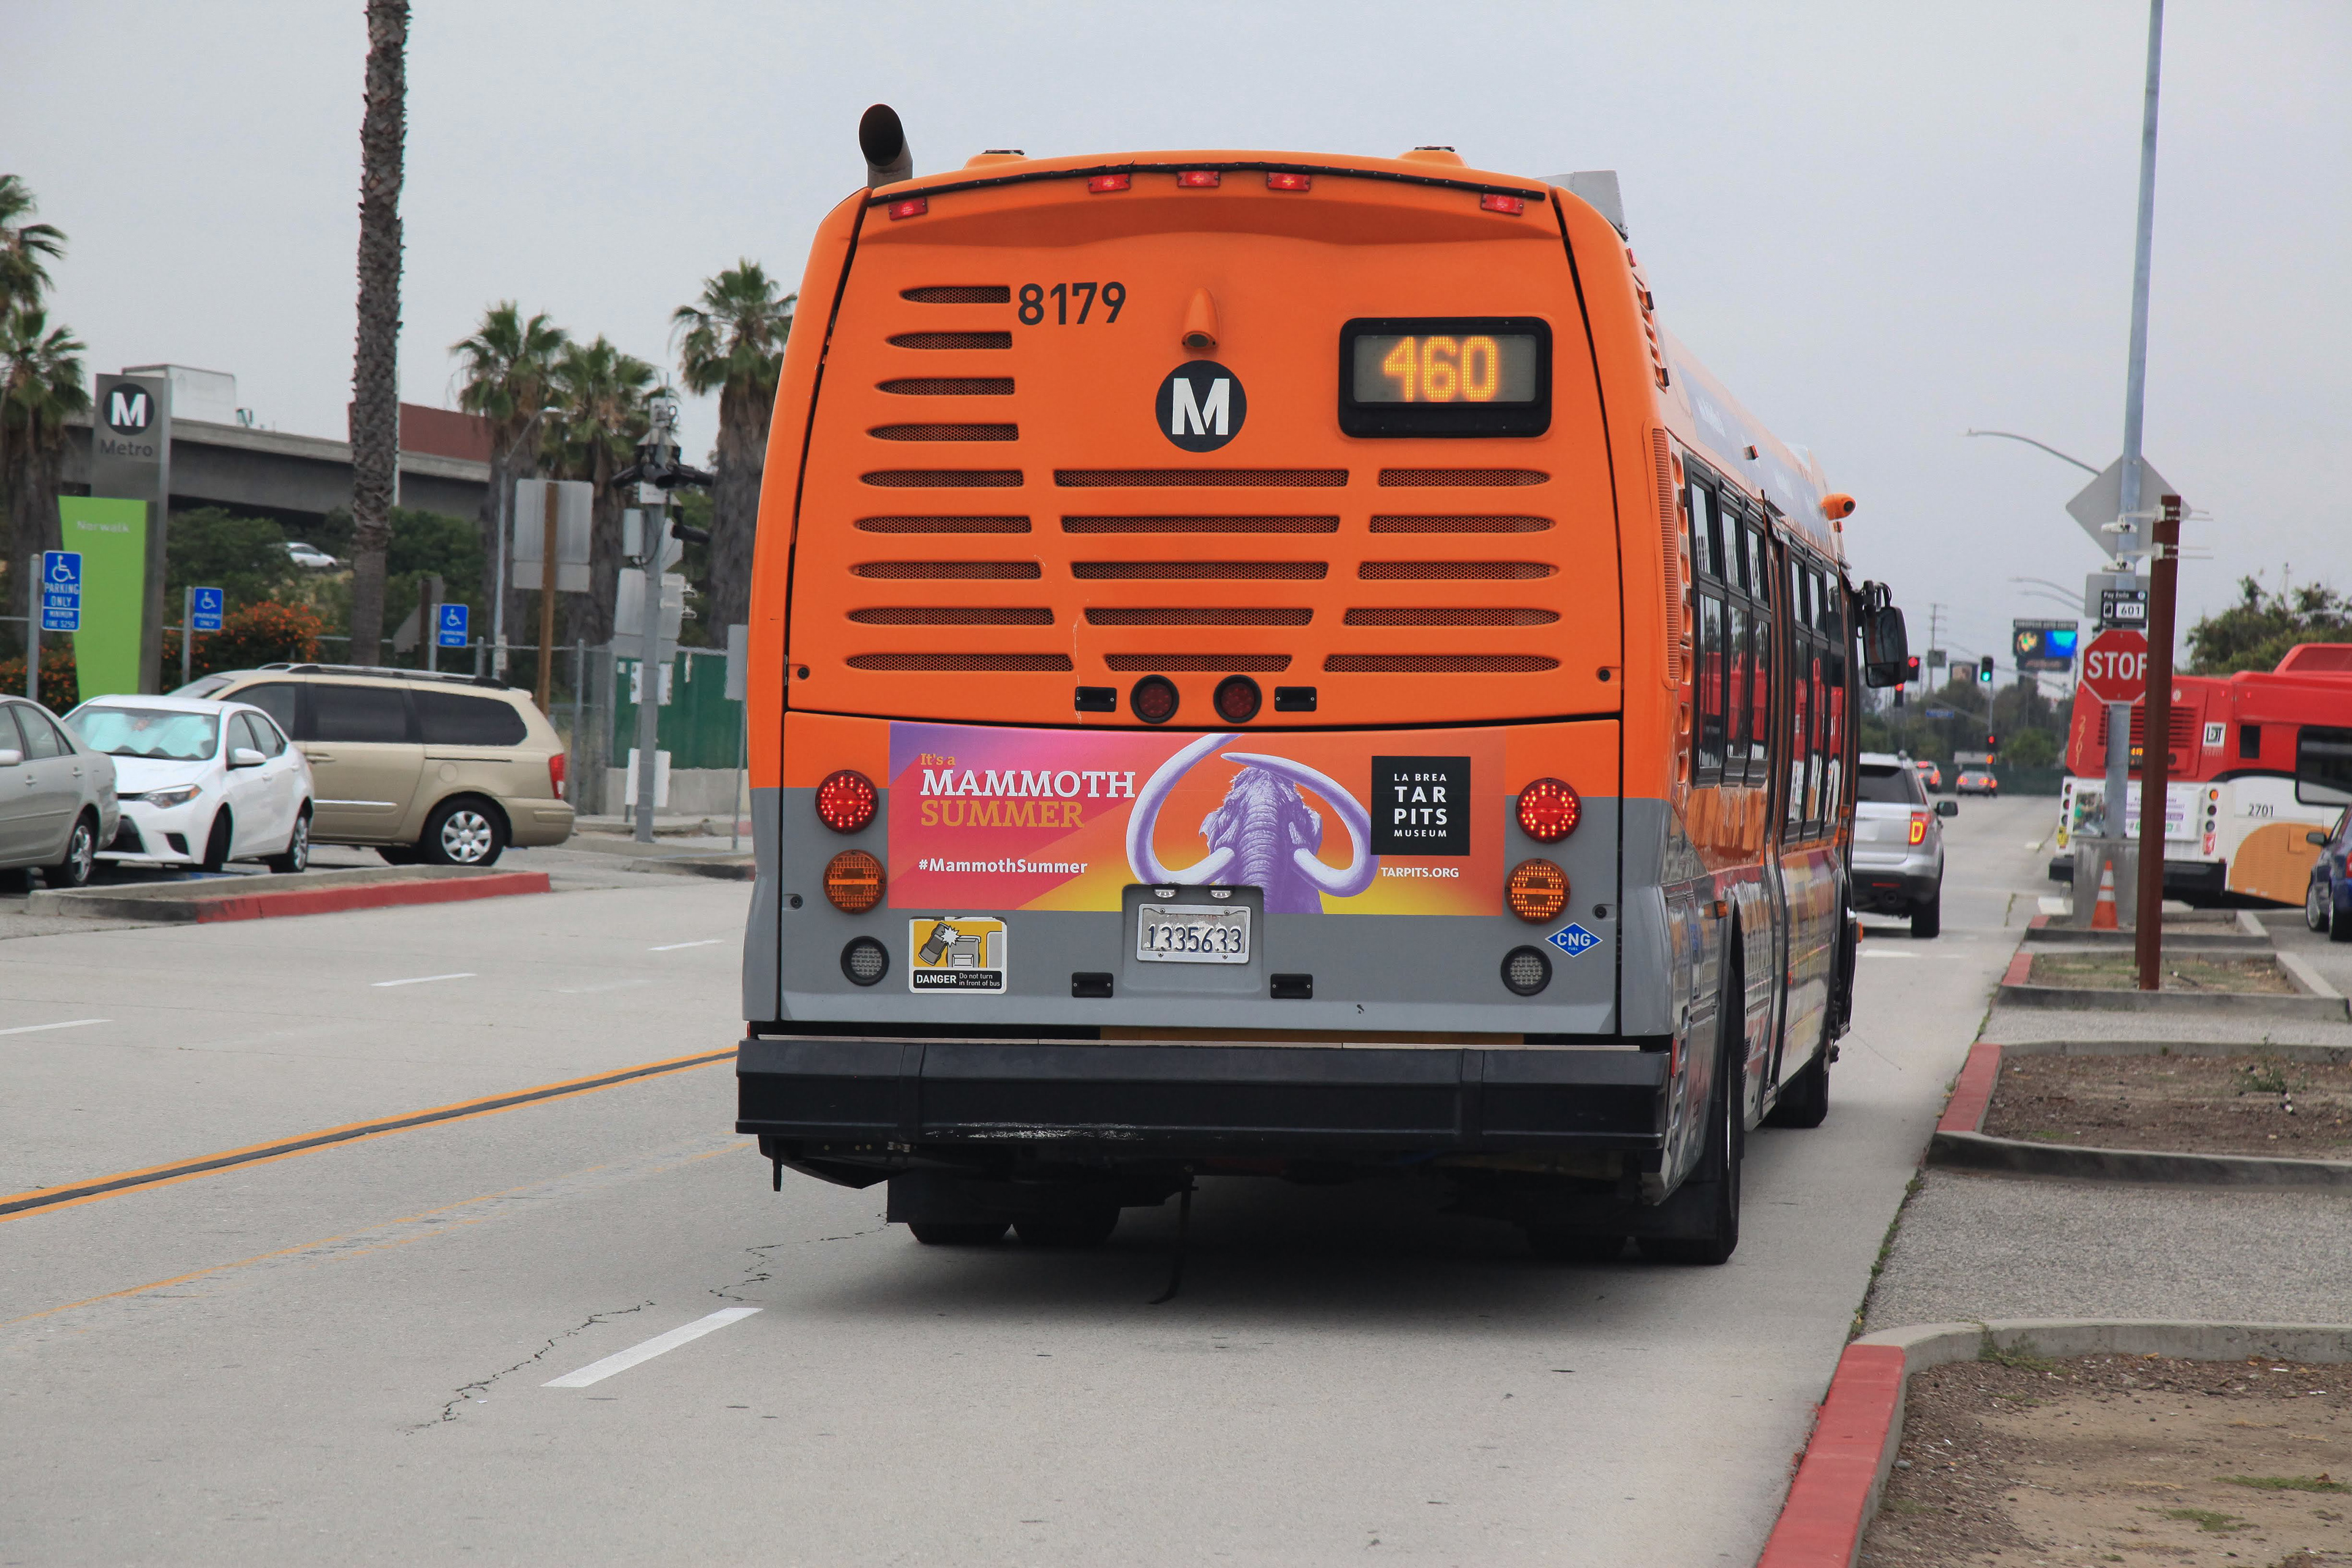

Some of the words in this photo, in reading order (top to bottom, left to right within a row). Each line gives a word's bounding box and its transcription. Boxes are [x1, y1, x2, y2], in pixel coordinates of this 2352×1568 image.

[1018, 282, 1126, 325] 8179
[1384, 336, 1496, 402] 460
[111, 391, 146, 427] M
[1172, 378, 1229, 435] M
[100, 439, 153, 457] Metro
[77, 521, 130, 533] Norwalk
[45, 582, 79, 595] PARKING
[51, 595, 72, 607] ONLY
[2121, 605, 2140, 616] 601
[921, 753, 943, 766] It's
[947, 756, 956, 766] a
[920, 769, 1136, 797] MAMMOTH
[1394, 786, 1447, 803] TAR
[921, 799, 1085, 828] SUMMER
[1394, 808, 1447, 825] PITS
[2248, 803, 2274, 818] 2701
[919, 858, 1088, 874] #MammothSummer
[1381, 867, 1459, 878] TARPITS.ORG
[1148, 925, 1242, 954] 1335633
[1557, 932, 1591, 947] CNG
[916, 974, 957, 984] DANGER
